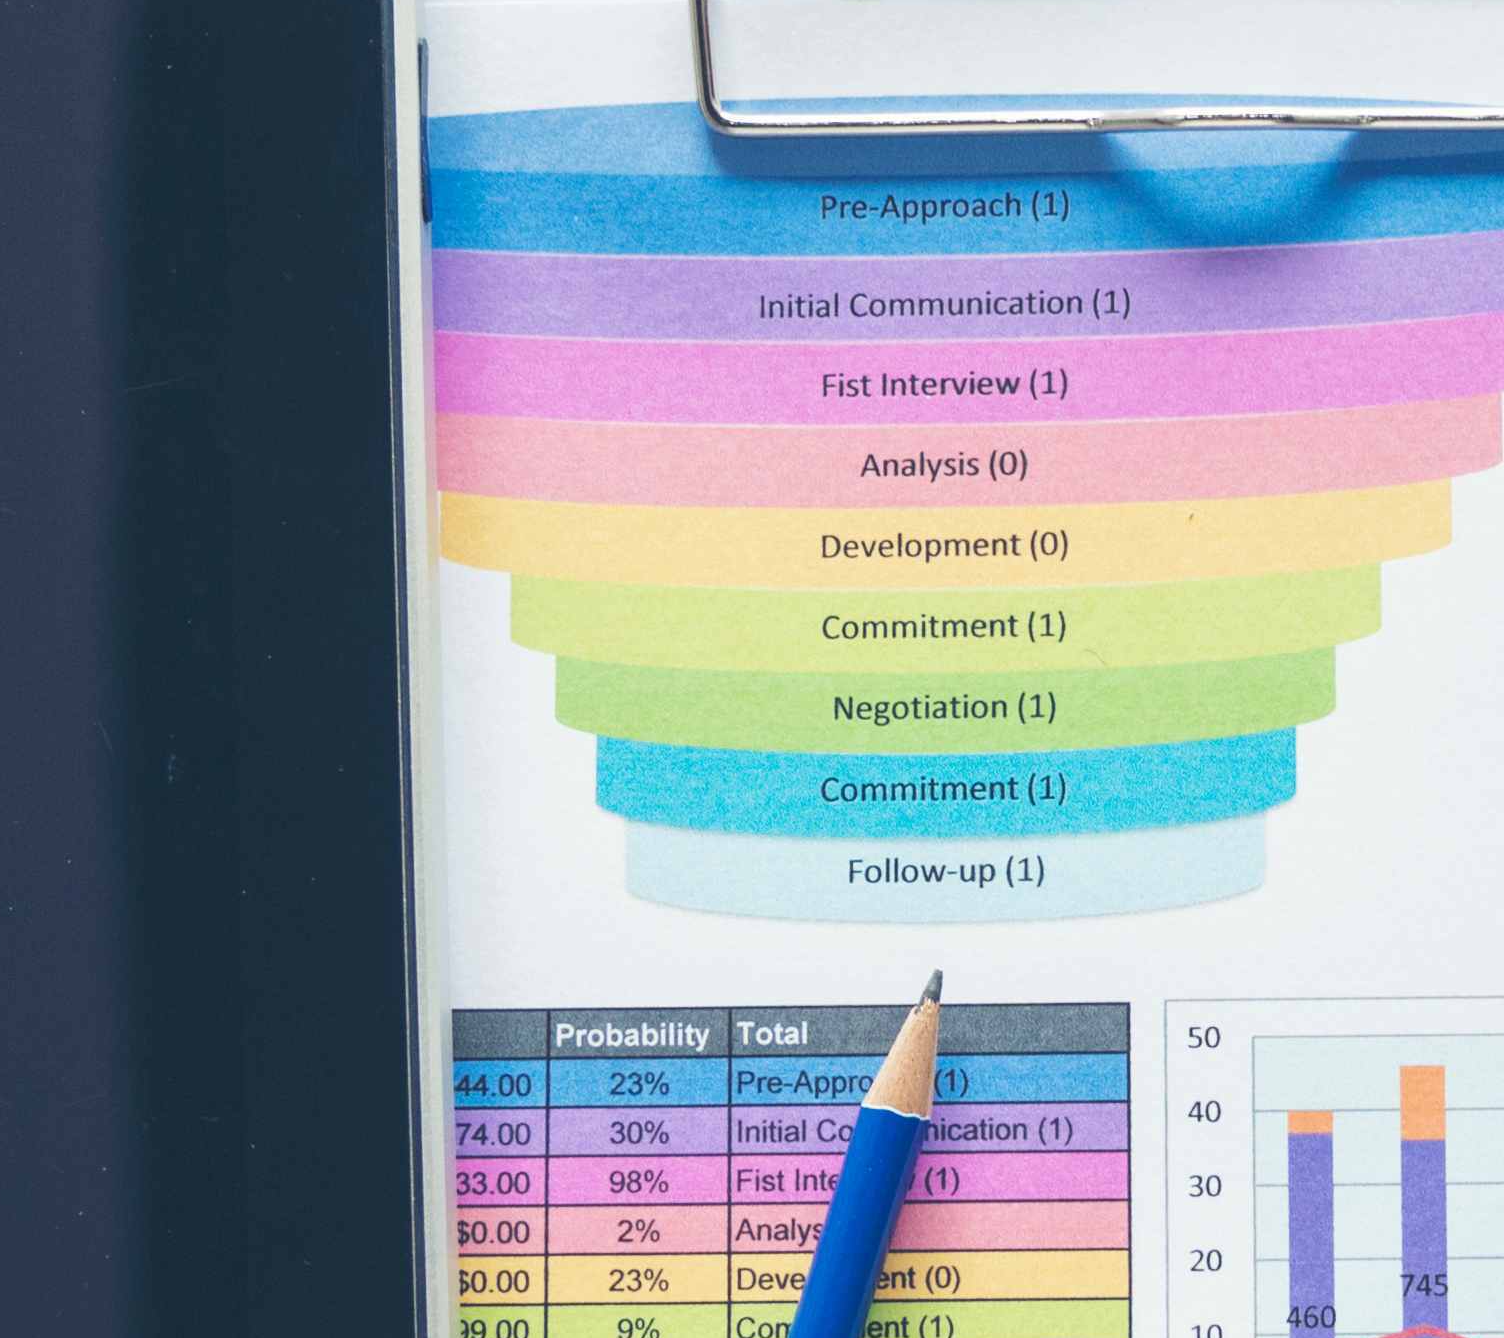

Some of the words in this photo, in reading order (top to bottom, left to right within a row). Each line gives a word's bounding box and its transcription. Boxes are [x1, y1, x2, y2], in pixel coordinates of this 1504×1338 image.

[822, 192, 1020, 224] Pre-Approach
[1032, 190, 1068, 221] (1)
[760, 293, 839, 318] Initial
[850, 290, 1082, 317] Communication
[1093, 288, 1130, 319] (1)
[823, 373, 871, 397] Fist
[882, 371, 1020, 396] Interview
[1030, 368, 1068, 400] (1)
[861, 451, 979, 483] Analysis
[989, 449, 1028, 481] (0)
[822, 533, 1021, 563] Development
[1030, 530, 1068, 562] (0)
[822, 614, 1018, 639] Commitment
[1028, 611, 1066, 643] (1)
[834, 694, 1007, 726] Negotiation
[1018, 692, 1056, 724] (1)
[821, 776, 1018, 802] Commitment
[1028, 773, 1065, 806] (1)
[849, 858, 996, 888] Follow-up
[1006, 856, 1044, 888] (1)
[557, 1023, 709, 1051] Probability
[737, 1021, 807, 1045] Total
[1189, 1026, 1221, 1048] 50
[610, 1072, 669, 1096] 23%
[1188, 1100, 1221, 1123] 40
[610, 1121, 669, 1144] 30%
[738, 1120, 806, 1143] Initial
[609, 1170, 669, 1193] 98%
[737, 1169, 784, 1192] Fist
[1189, 1175, 1222, 1197] 30
[618, 1219, 660, 1243] 2%
[1191, 1249, 1222, 1272] 20
[609, 1268, 669, 1292] 23%
[1402, 1274, 1448, 1297] 745
[1285, 1306, 1336, 1329] 460
